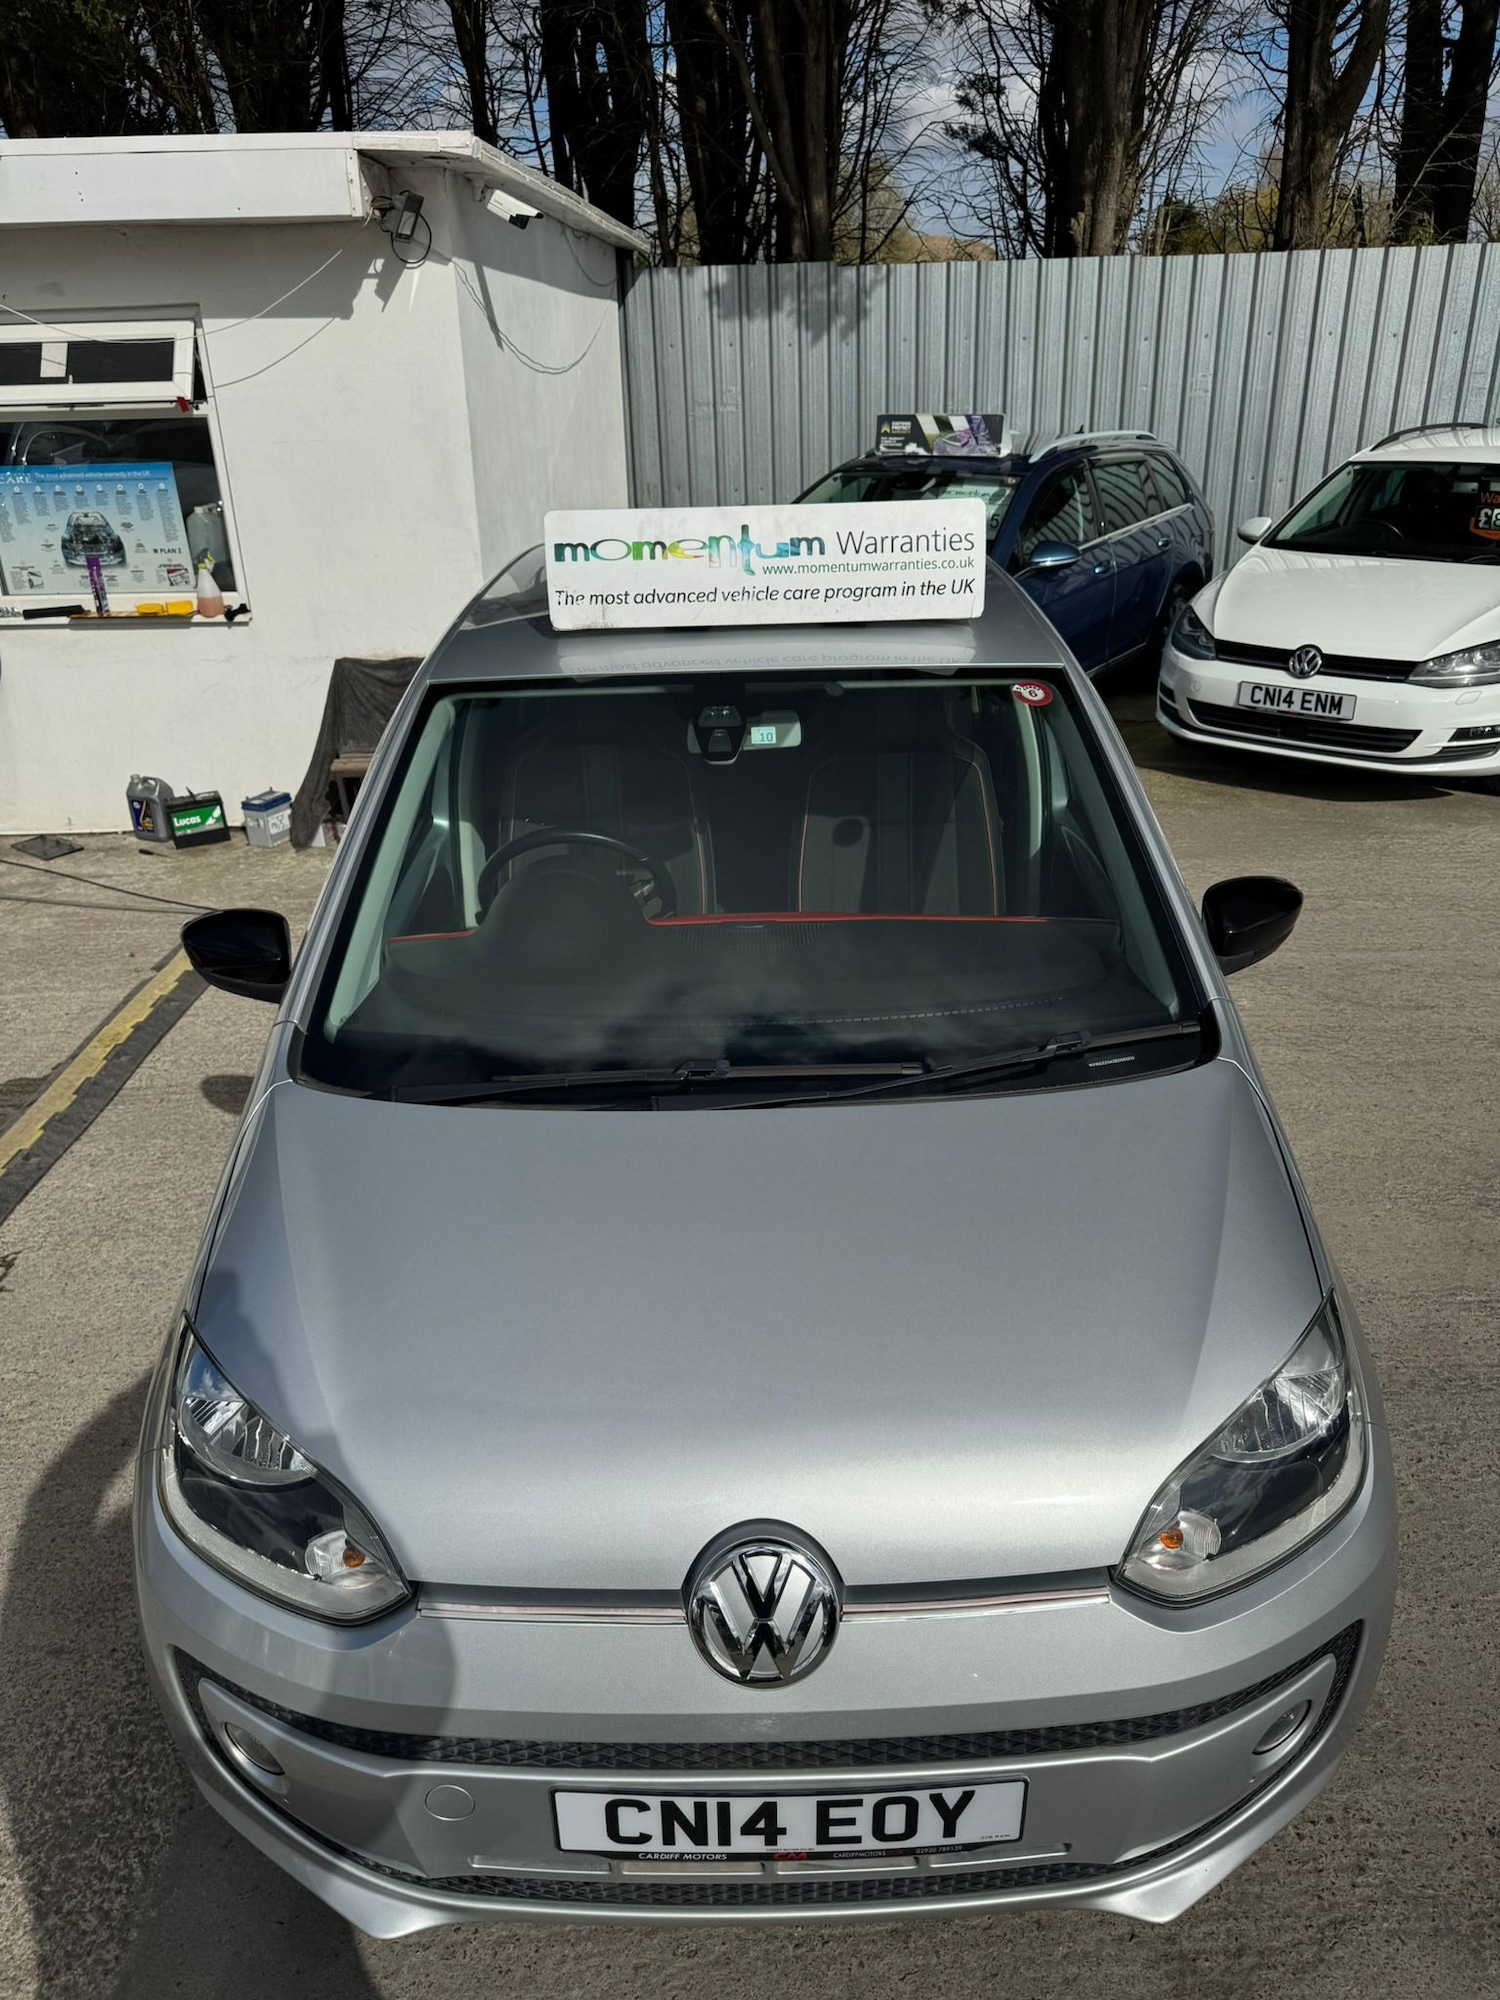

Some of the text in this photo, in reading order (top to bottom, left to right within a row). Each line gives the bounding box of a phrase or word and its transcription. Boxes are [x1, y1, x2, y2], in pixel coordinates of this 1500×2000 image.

[554, 524, 975, 576] momentum Warranties
[762, 556, 975, 576] www.momentumwarranties.co.uk
[555, 578, 976, 606] The most advanced vehicle care program in the UK
[1250, 685, 1343, 715] CN14 ENM
[760, 731, 773, 742] 10
[173, 815, 202, 827] Lucas
[605, 1790, 976, 1847] CN14 EOY
[638, 1852, 727, 1861] CARDIFF MOTORS
